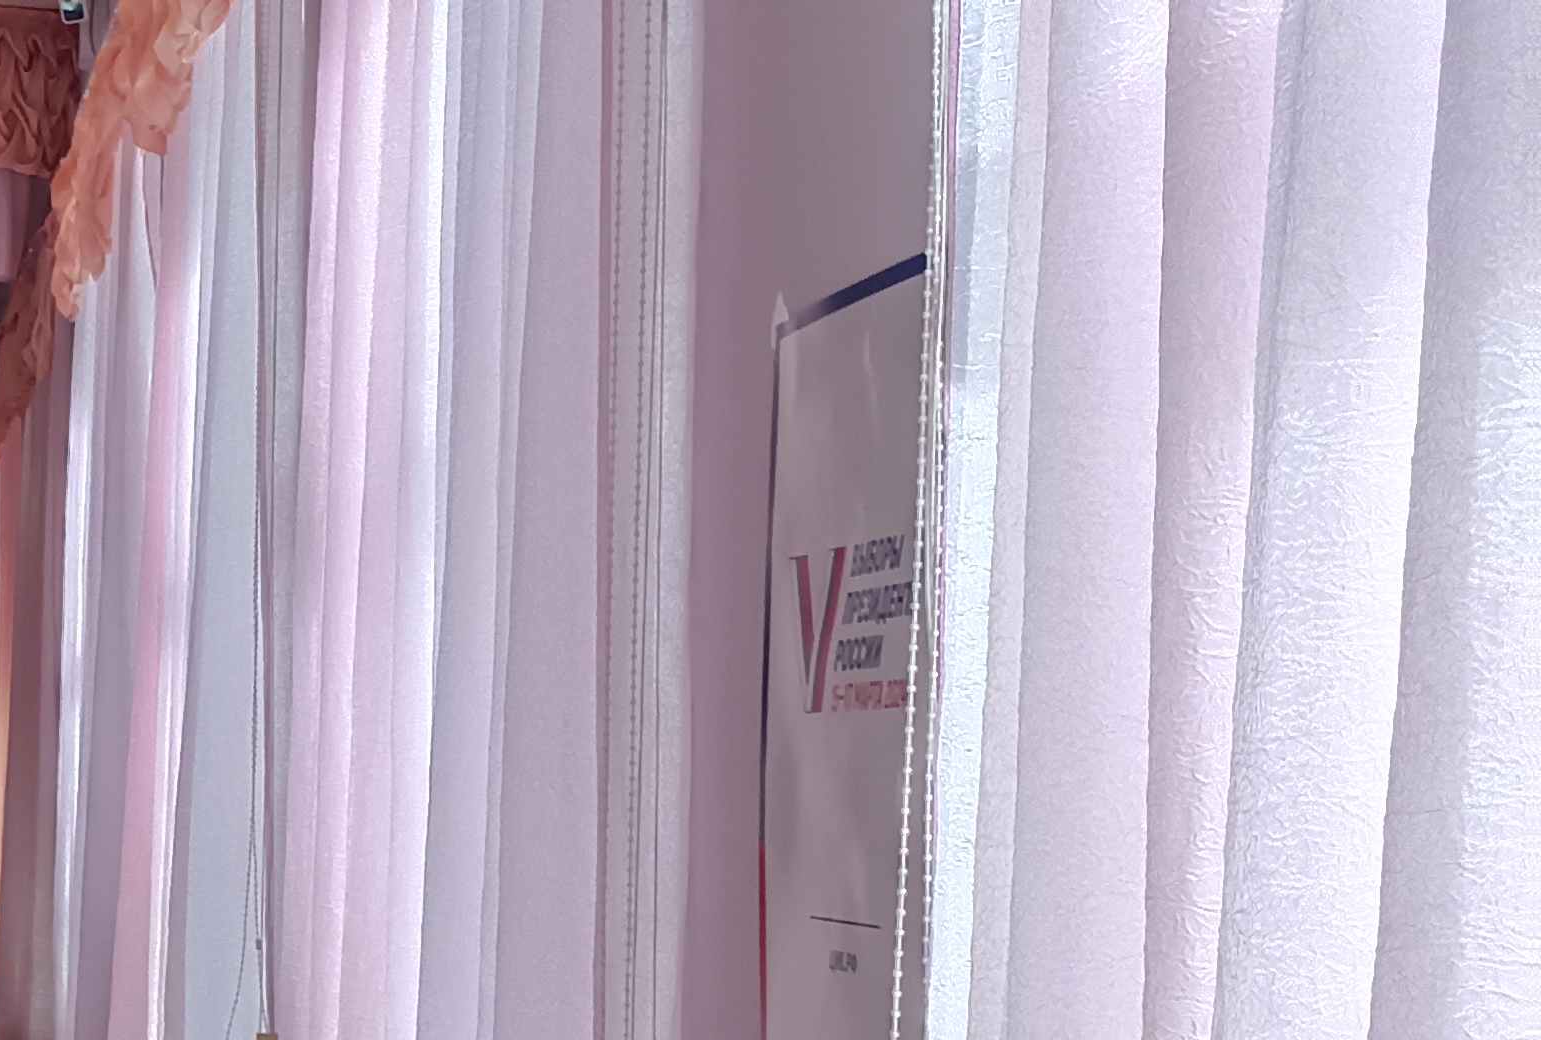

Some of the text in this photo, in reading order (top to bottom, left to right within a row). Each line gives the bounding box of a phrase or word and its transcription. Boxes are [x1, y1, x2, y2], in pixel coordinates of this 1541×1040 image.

[850, 534, 905, 577] ВЫБОРЫ
[841, 580, 914, 625] ПРЕЗИДЕНТ
[833, 634, 885, 672] РОССИИ
